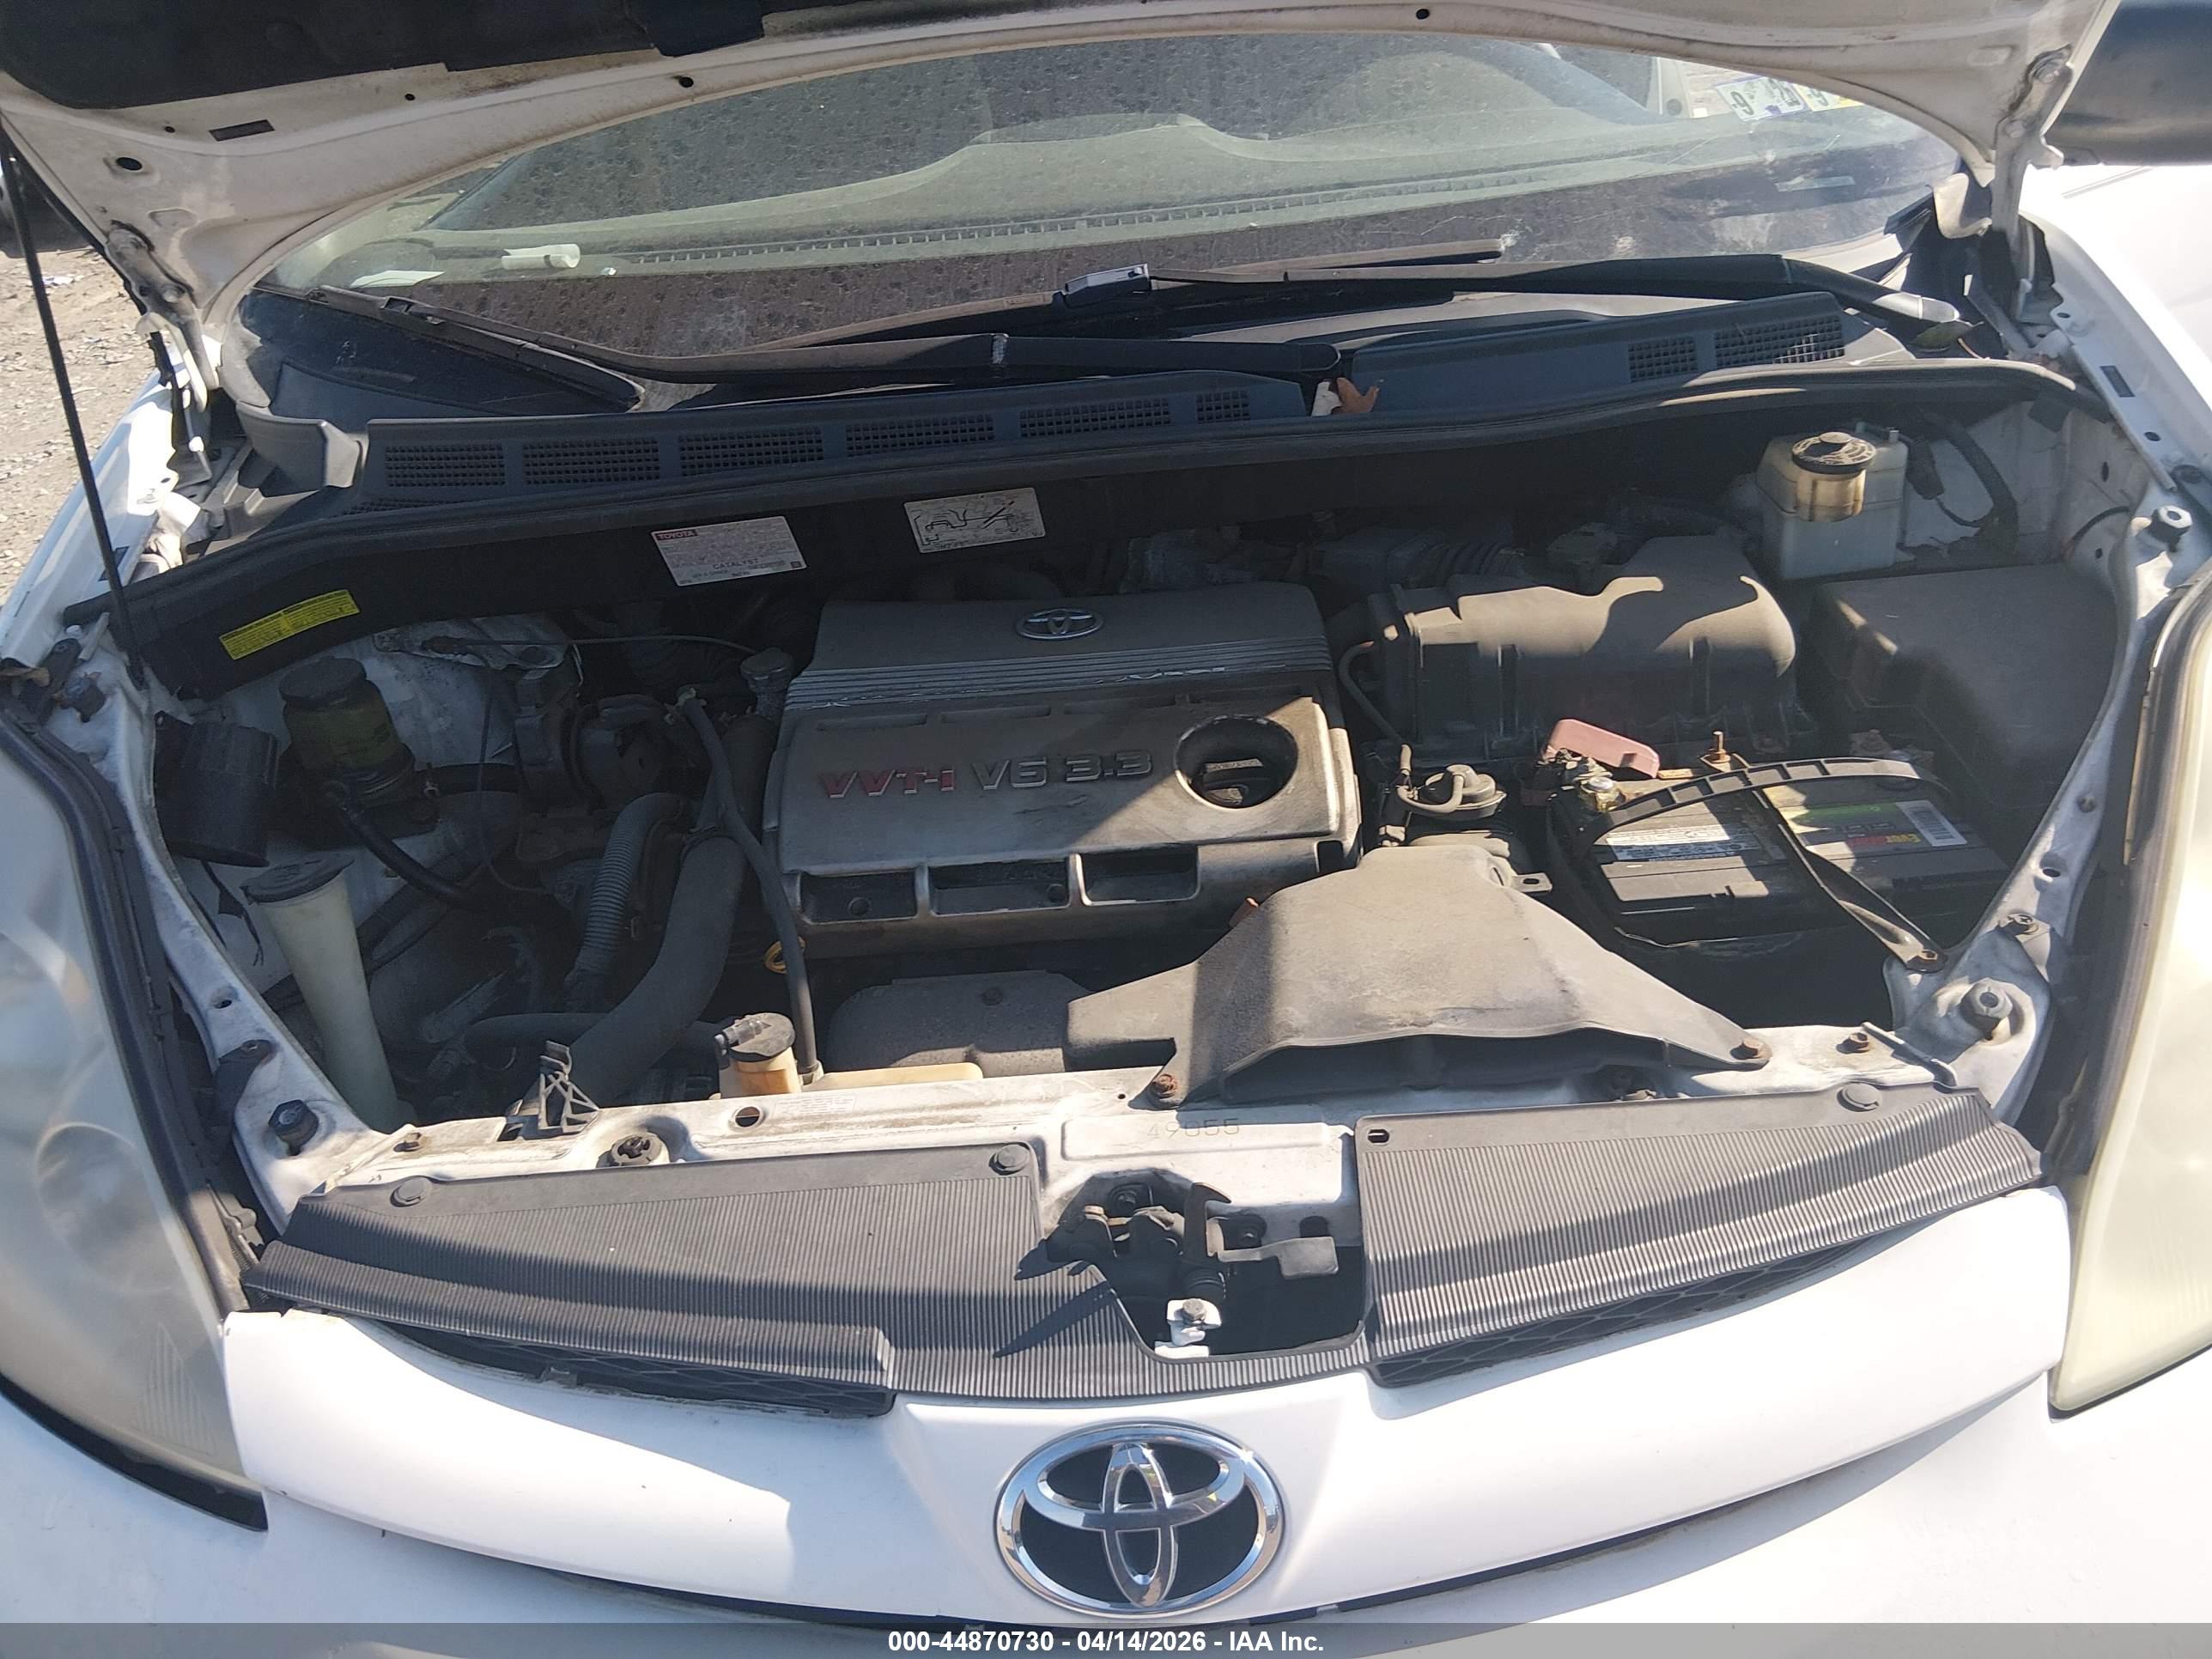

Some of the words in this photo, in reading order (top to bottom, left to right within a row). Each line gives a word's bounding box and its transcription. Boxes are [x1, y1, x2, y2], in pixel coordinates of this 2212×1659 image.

[657, 530, 696, 540] TOYOTA
[713, 558, 759, 569] CATALYST
[971, 757, 1048, 791] V6
[1065, 749, 1153, 782] 3.3
